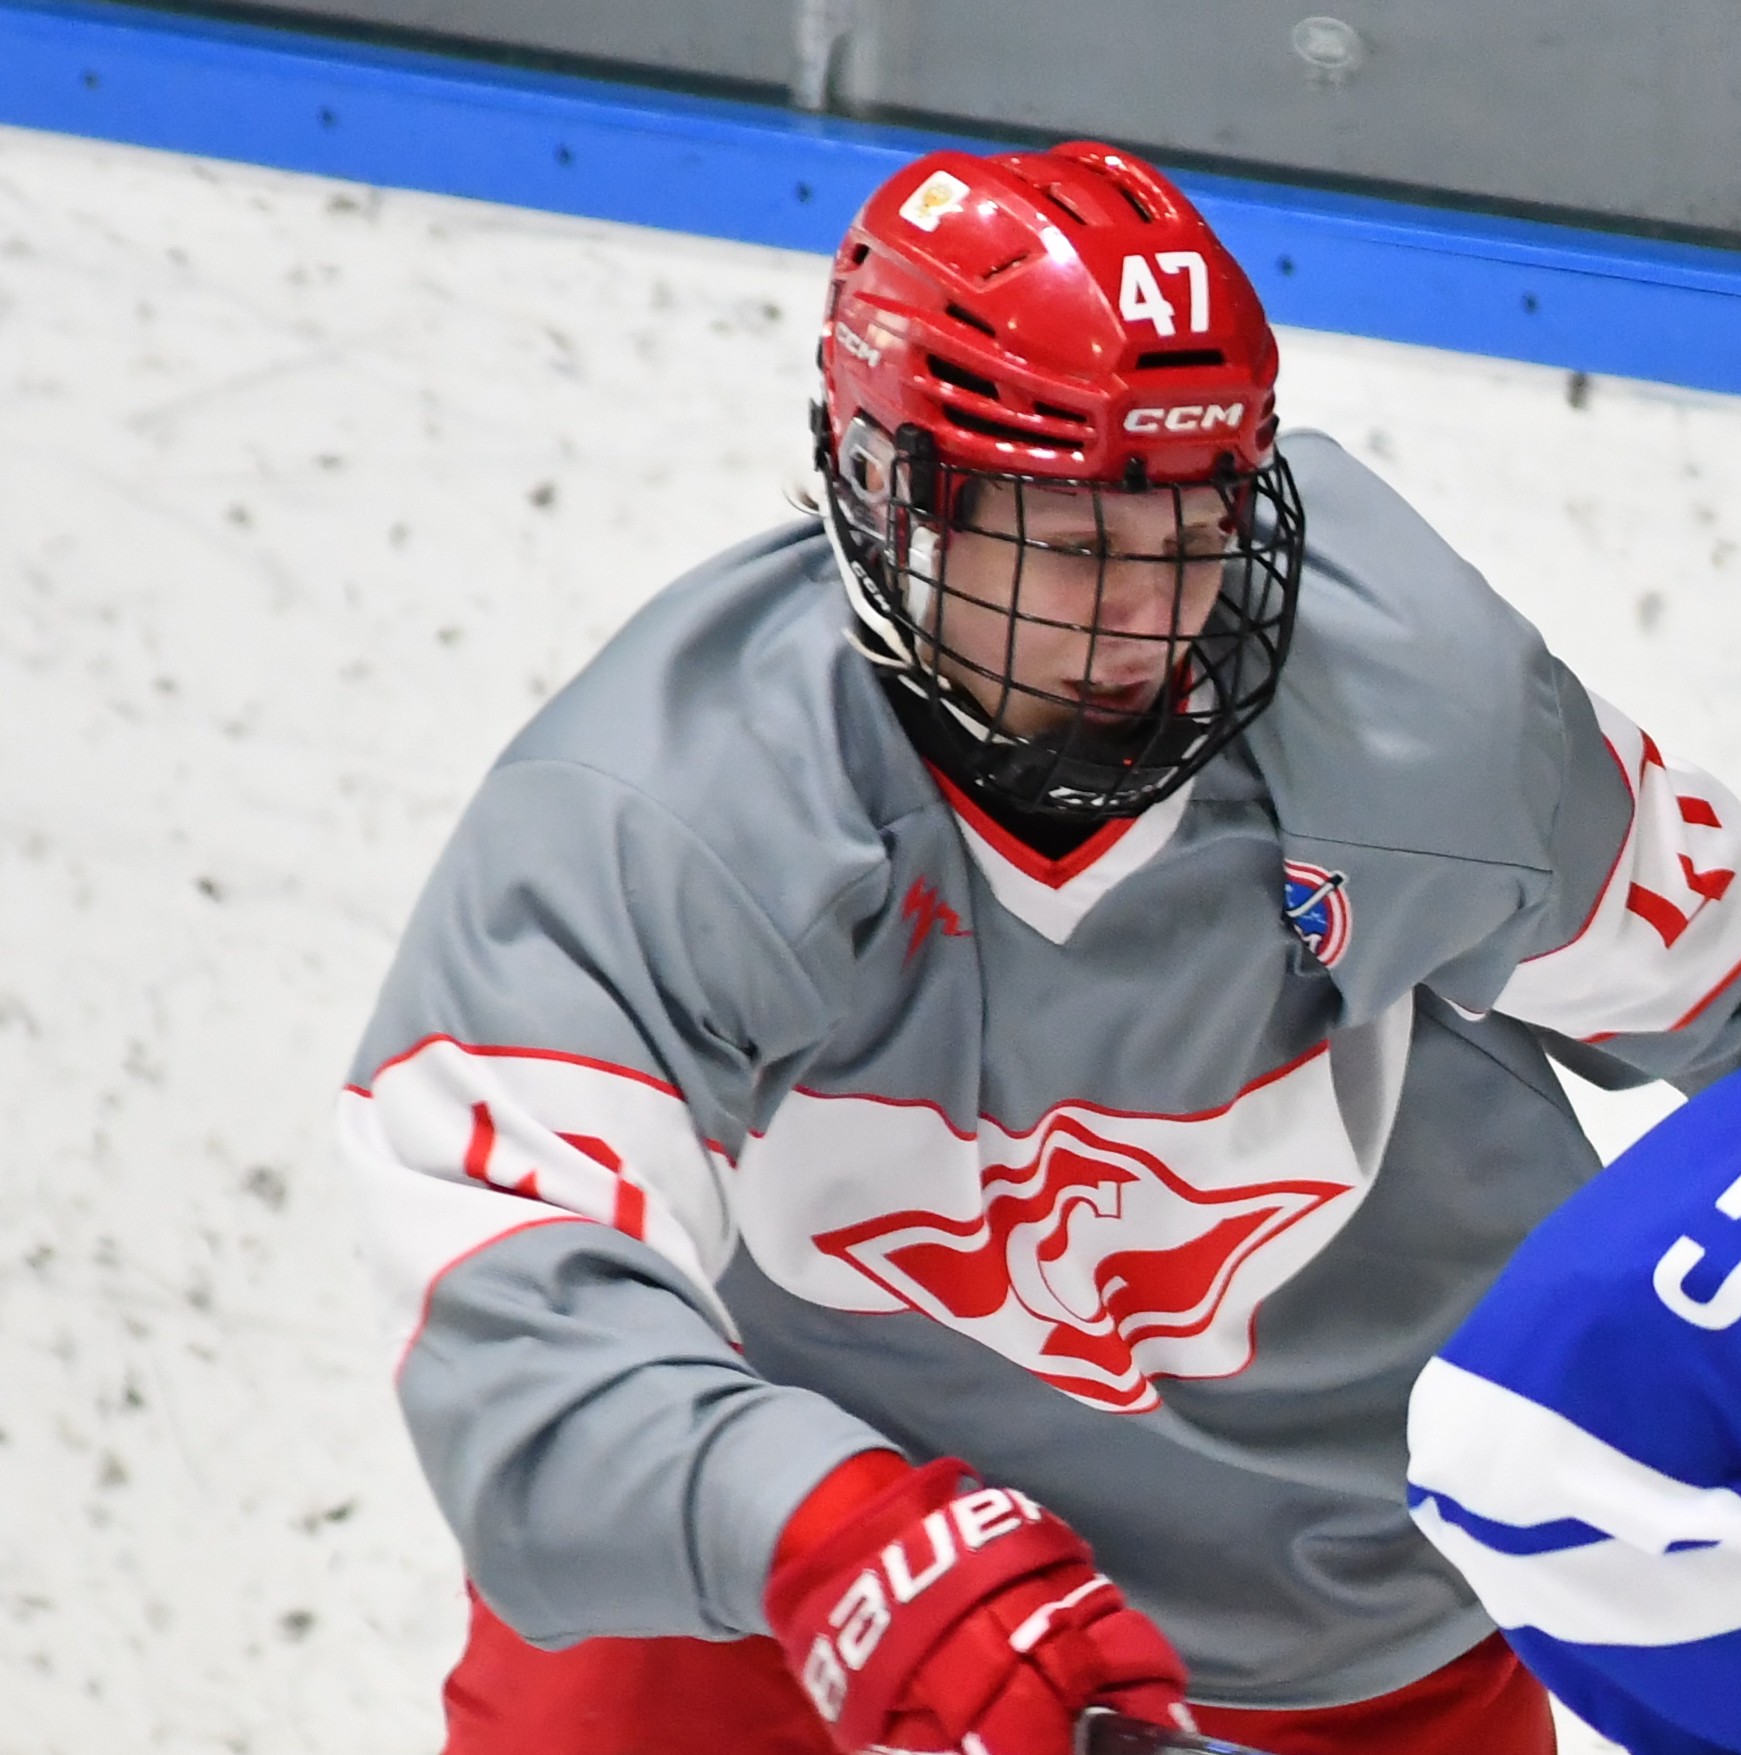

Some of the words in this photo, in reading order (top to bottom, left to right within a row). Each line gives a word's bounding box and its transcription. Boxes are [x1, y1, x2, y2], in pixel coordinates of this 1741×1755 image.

[1118, 250, 1210, 336] 47
[836, 321, 881, 367] CCM
[1123, 402, 1244, 434] CCM
